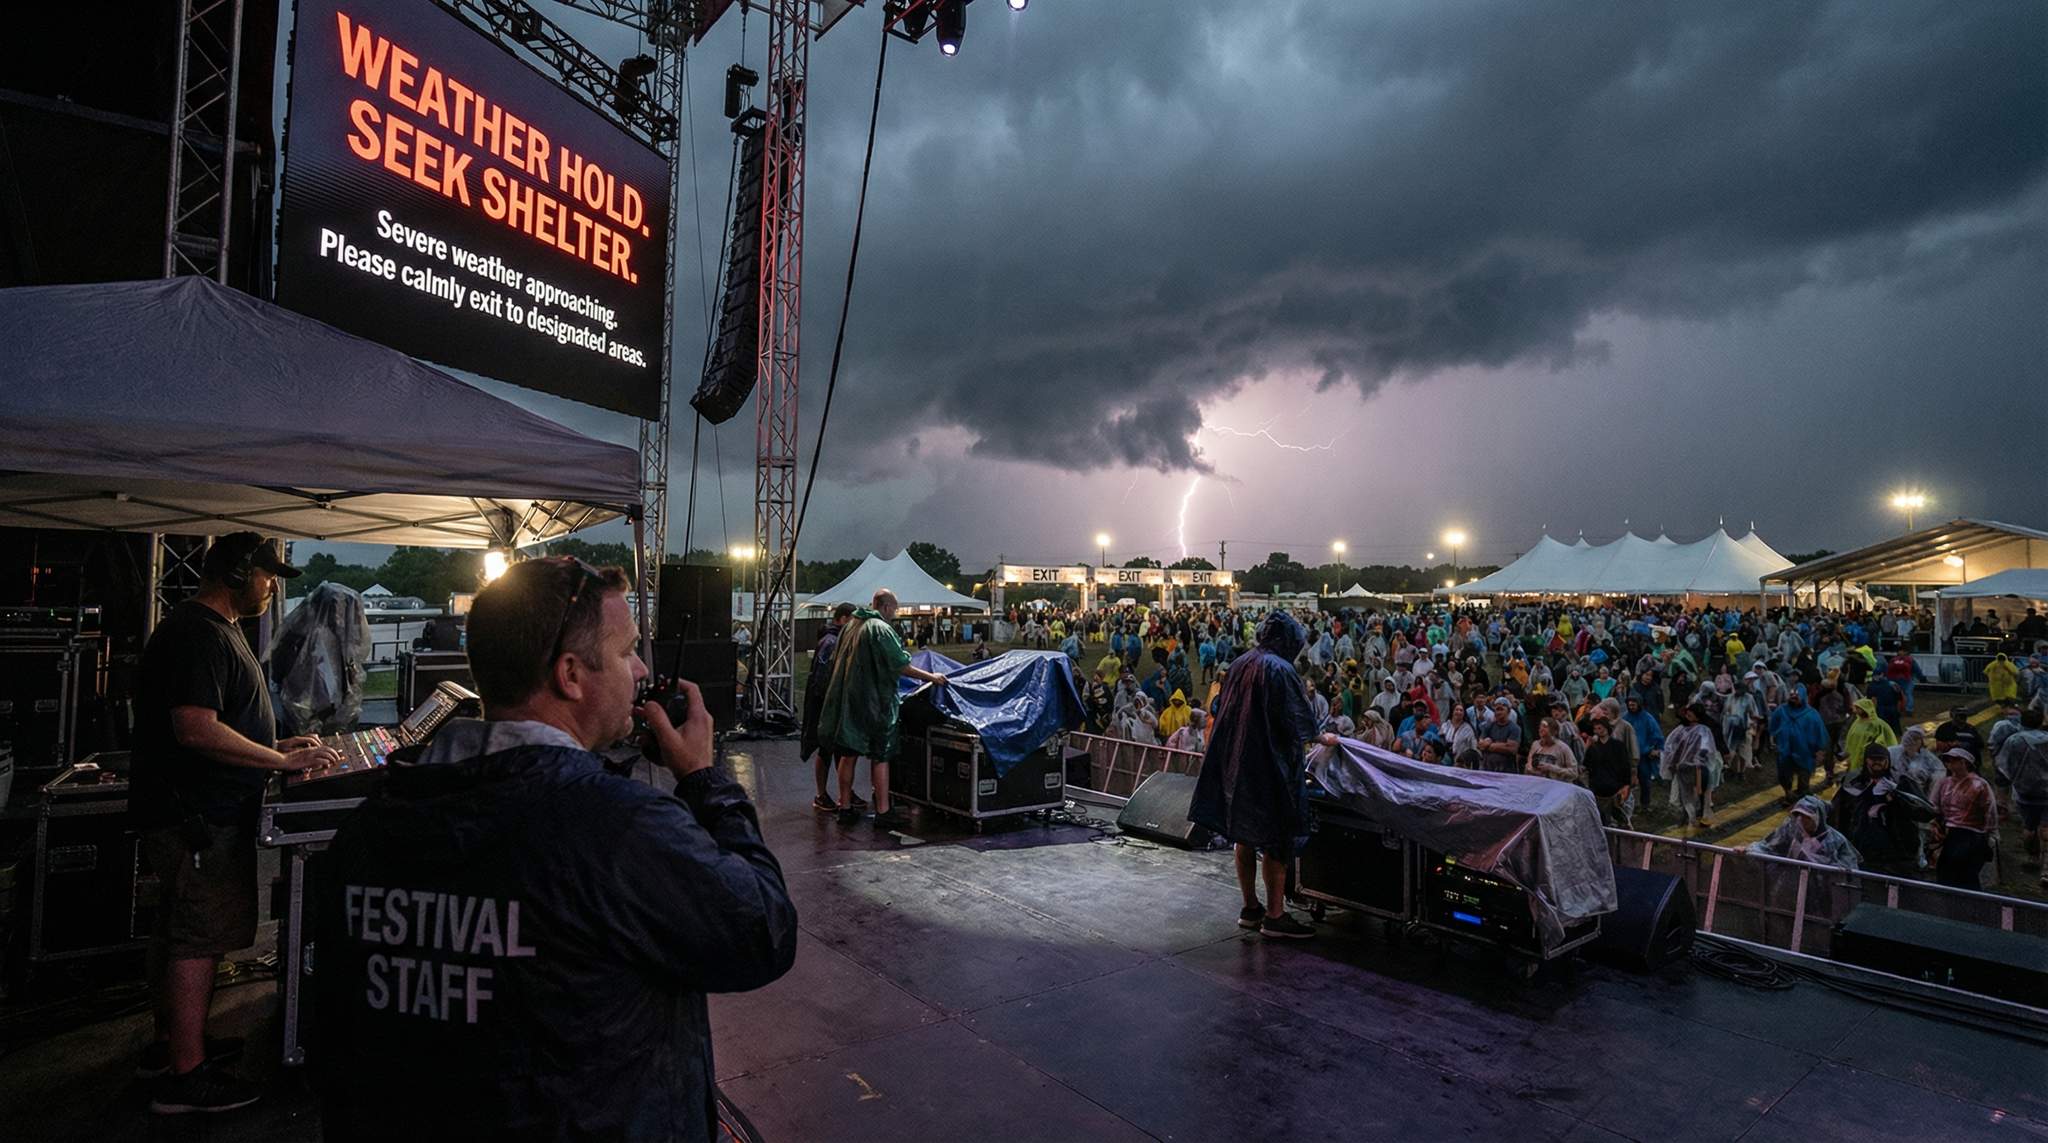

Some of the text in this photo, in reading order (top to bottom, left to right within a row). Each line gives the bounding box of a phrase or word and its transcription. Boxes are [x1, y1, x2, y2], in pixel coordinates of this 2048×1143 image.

[337, 11, 650, 238] WEATHER HOLD.
[347, 99, 638, 283] SEEK SHELTER.
[320, 228, 647, 368] Please calmly exit to designated areas.
[377, 209, 618, 330] Severe weather approaching.
[1033, 568, 1059, 582] EXIT
[1119, 570, 1141, 582] EXIT
[1193, 572, 1212, 583] EXIT
[346, 884, 536, 957] FESTIVAL
[367, 954, 494, 1024] STAFF
